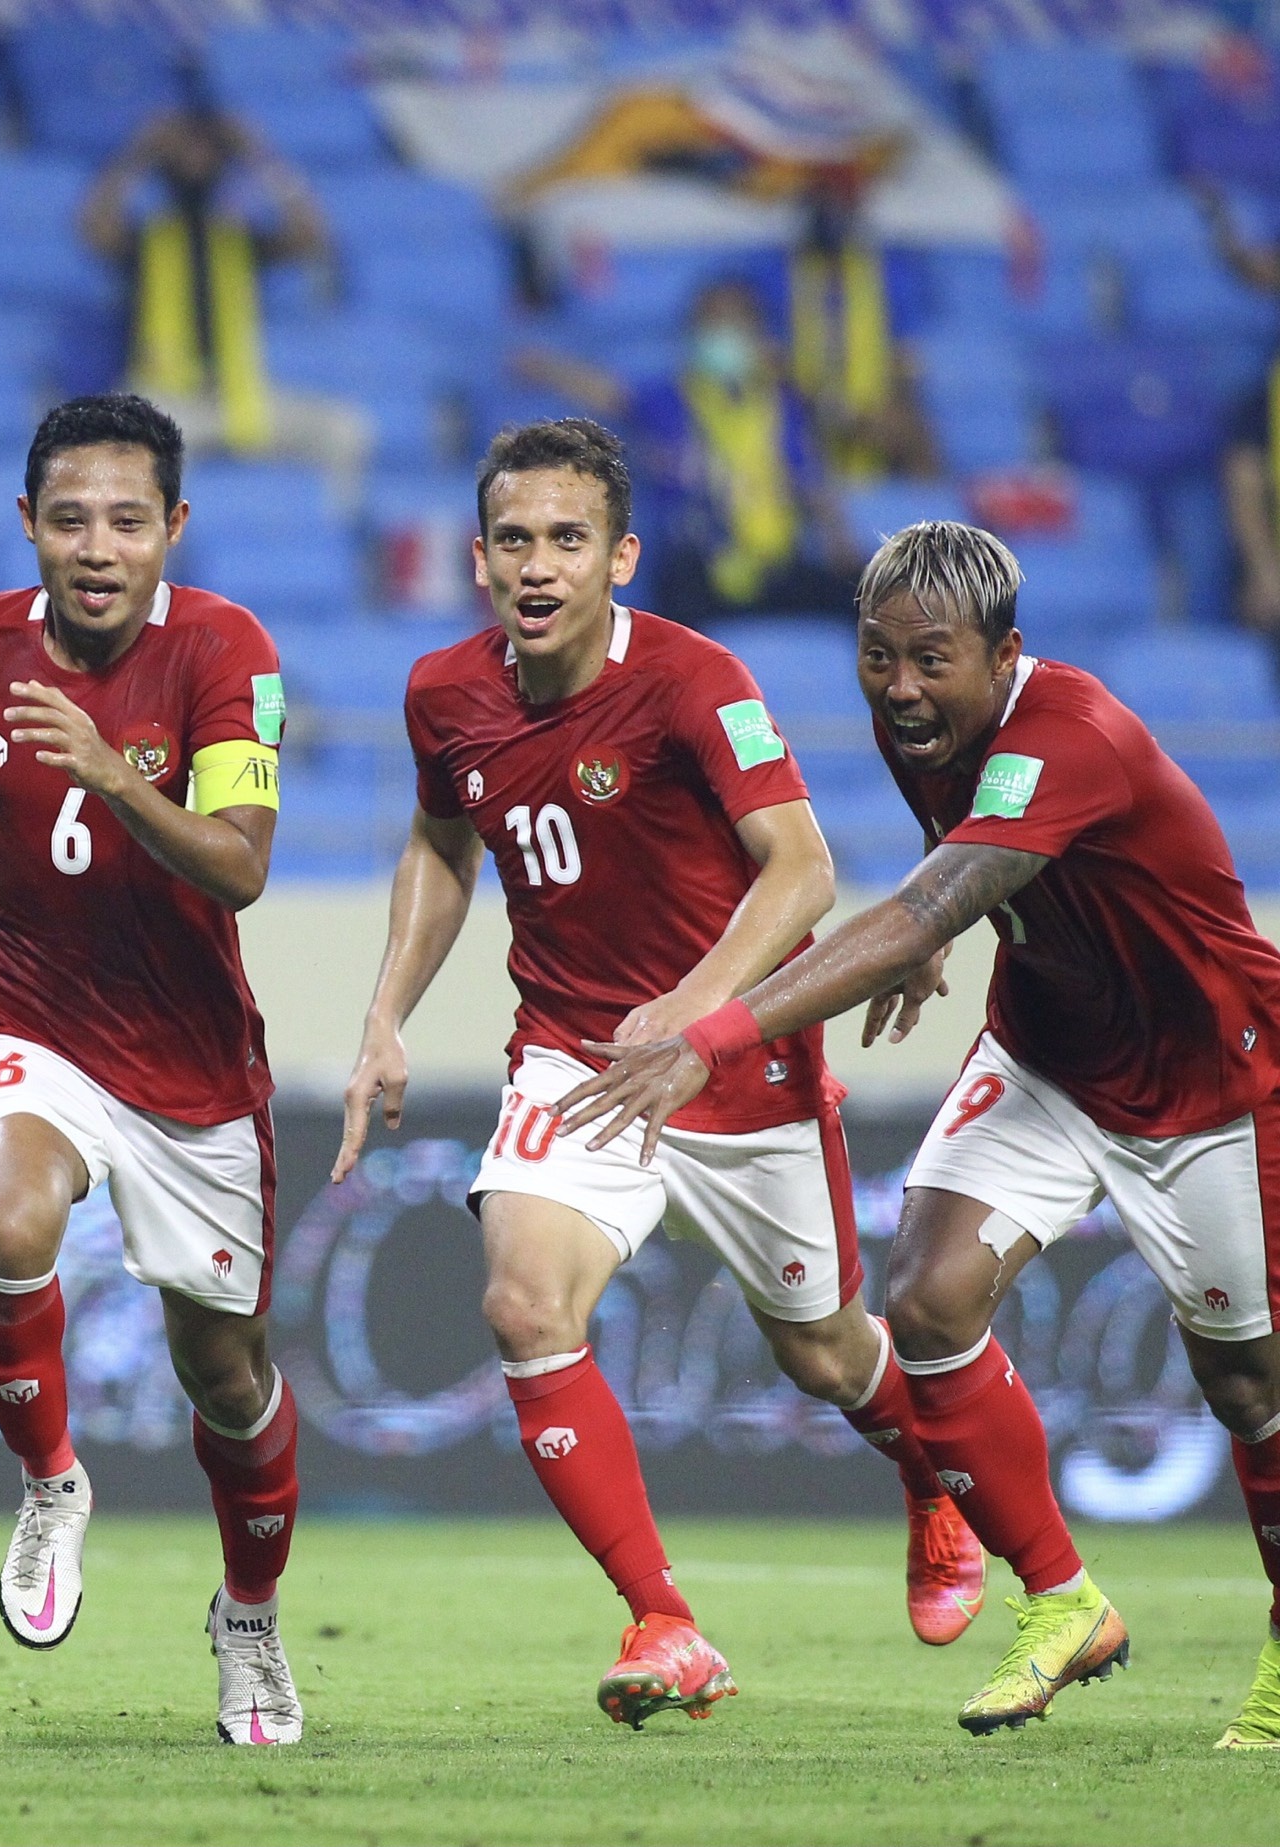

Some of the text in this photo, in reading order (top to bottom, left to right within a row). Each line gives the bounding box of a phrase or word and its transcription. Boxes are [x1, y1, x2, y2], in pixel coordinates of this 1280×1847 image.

[232, 757, 280, 790] AF
[51, 787, 92, 875] 6
[504, 803, 582, 886] 10
[492, 1090, 563, 1164] 10
[943, 1074, 1005, 1138] 9
